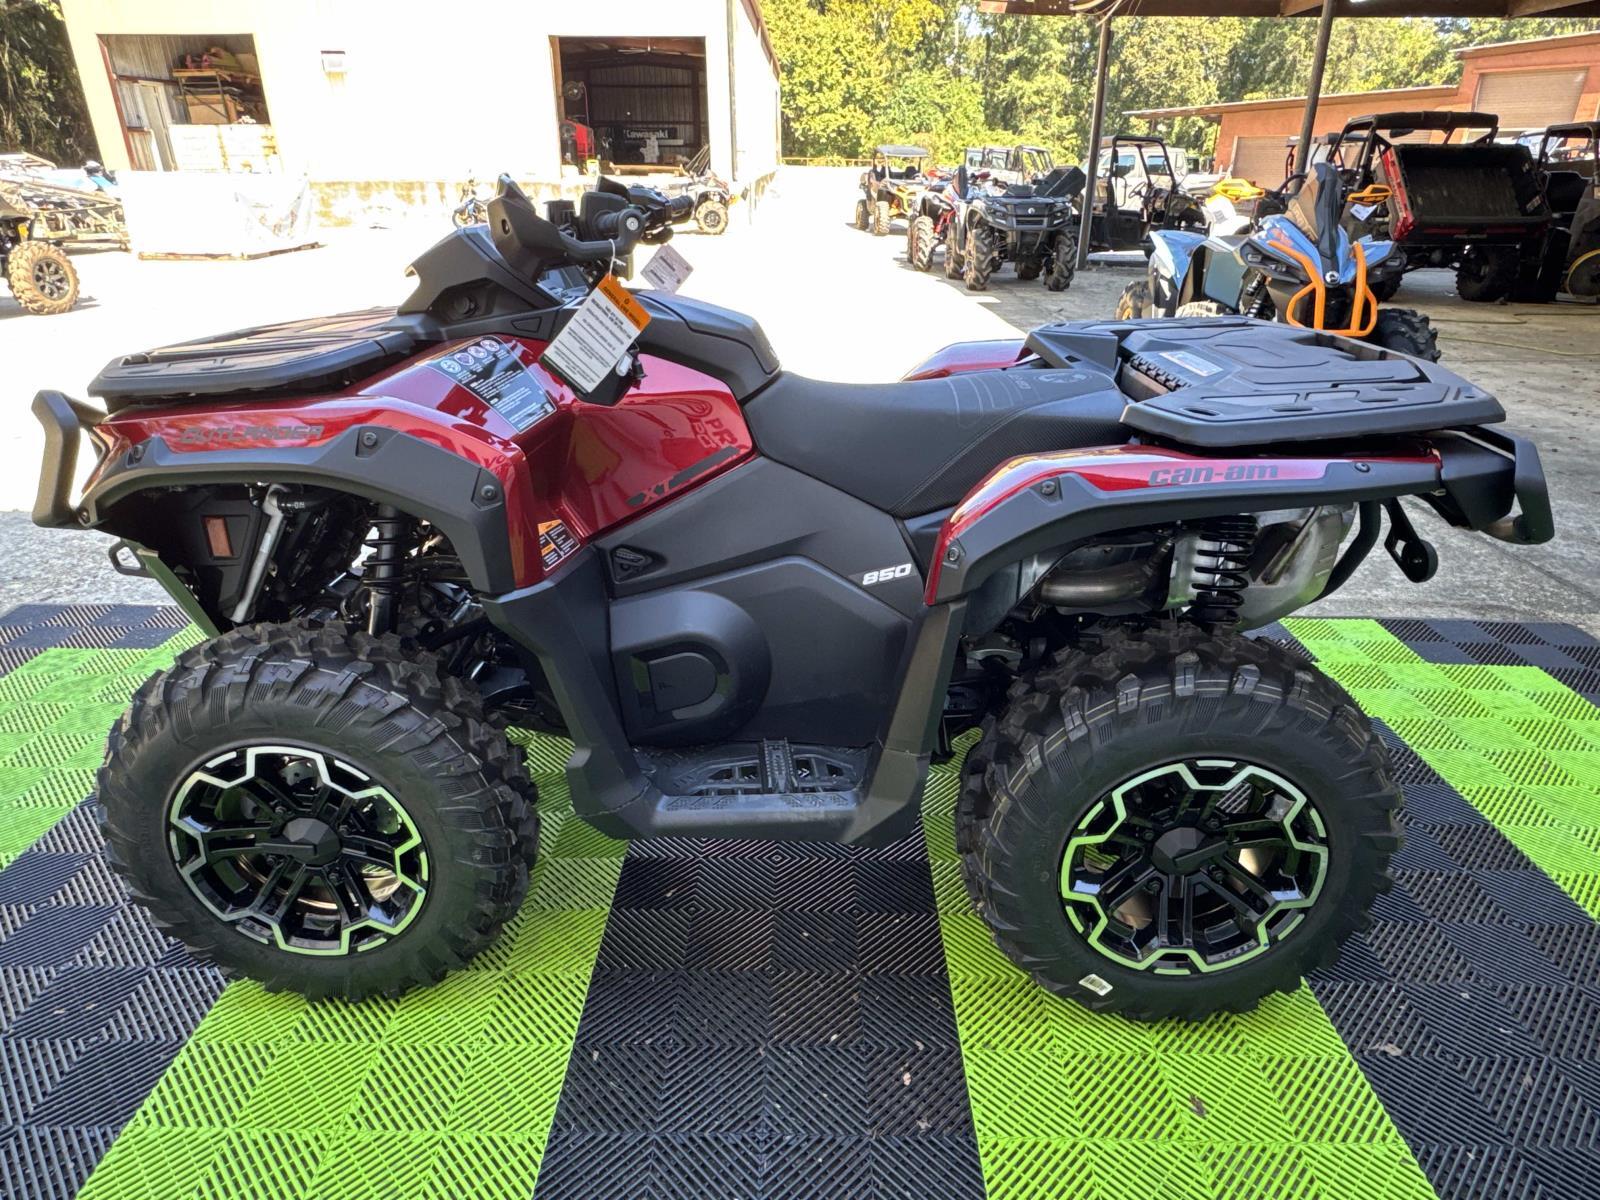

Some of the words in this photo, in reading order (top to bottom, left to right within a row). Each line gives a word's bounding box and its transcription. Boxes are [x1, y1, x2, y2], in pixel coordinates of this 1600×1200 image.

[179, 424, 325, 444] OUTLANDER
[1148, 464, 1279, 487] can-am
[862, 563, 912, 586] 850
